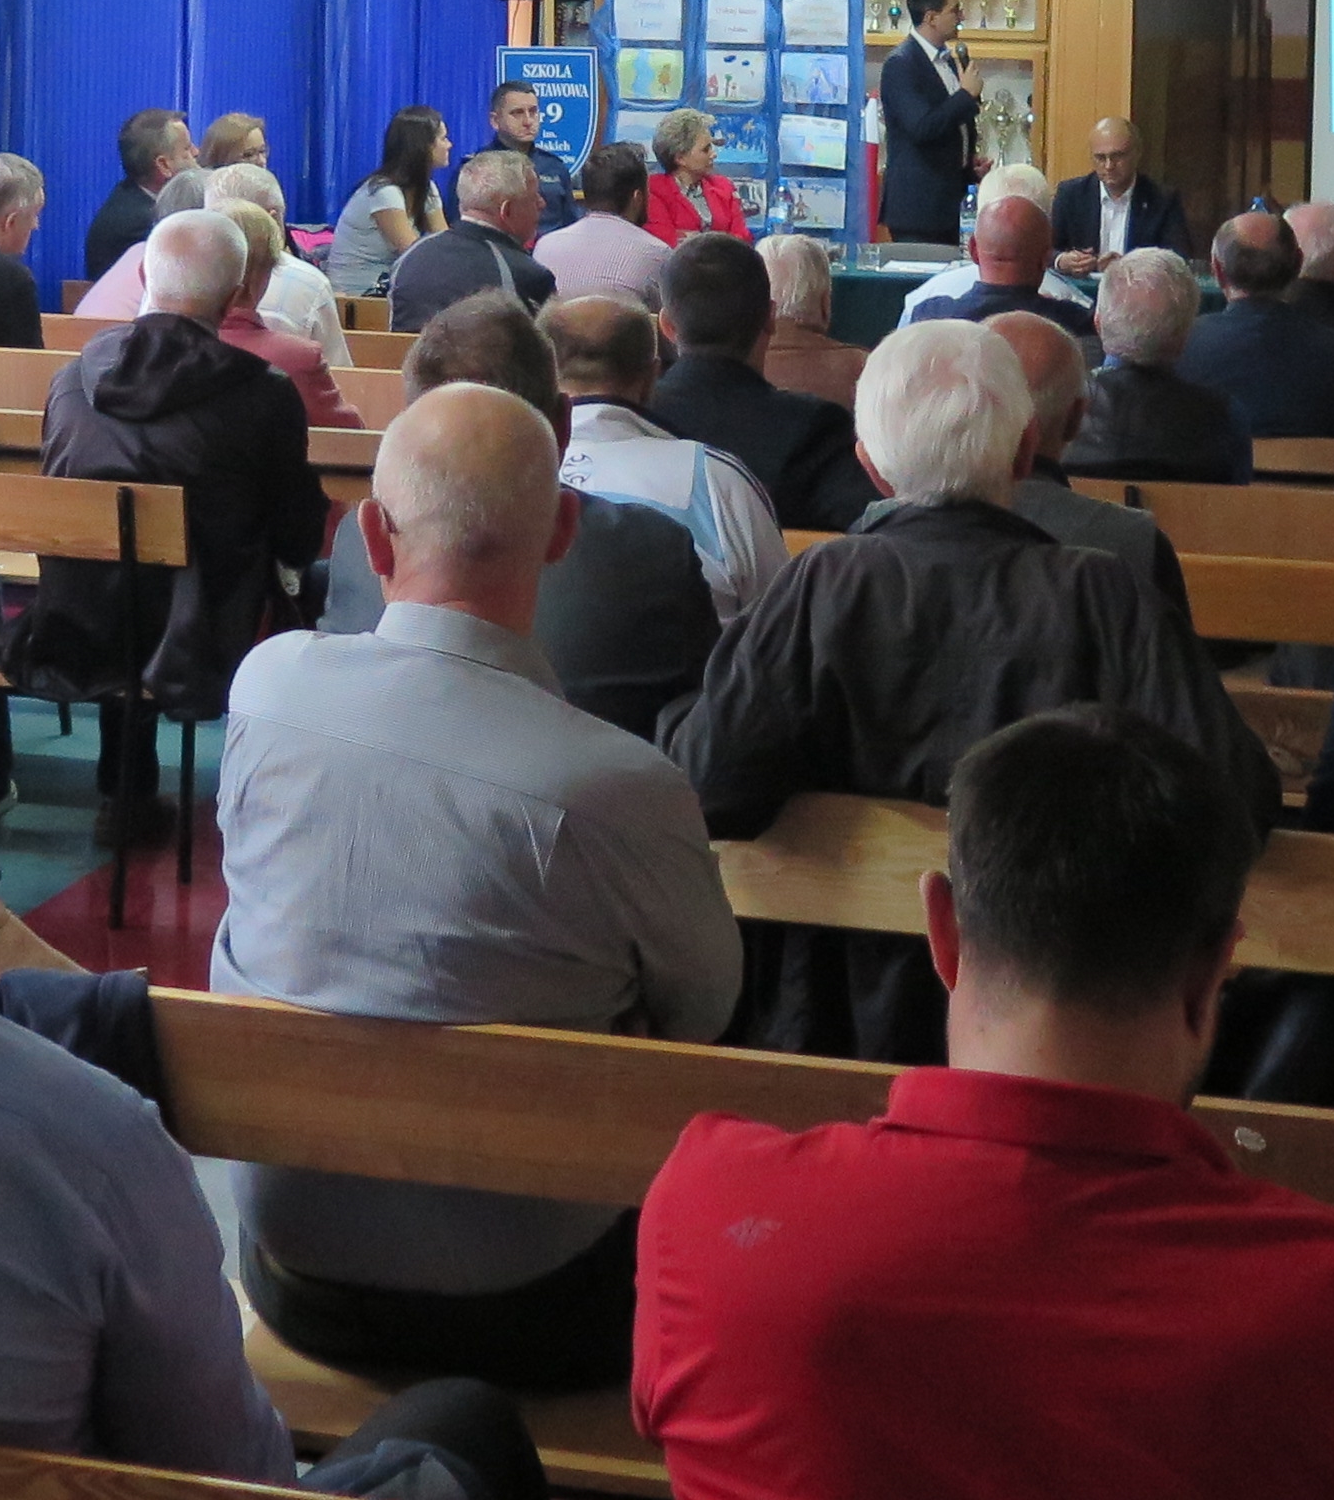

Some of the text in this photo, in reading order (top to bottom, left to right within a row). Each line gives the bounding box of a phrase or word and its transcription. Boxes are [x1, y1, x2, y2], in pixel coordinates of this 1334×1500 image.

[533, 83, 589, 98] STAWOWA
[546, 103, 563, 123] 9
[535, 141, 571, 151] olskich
